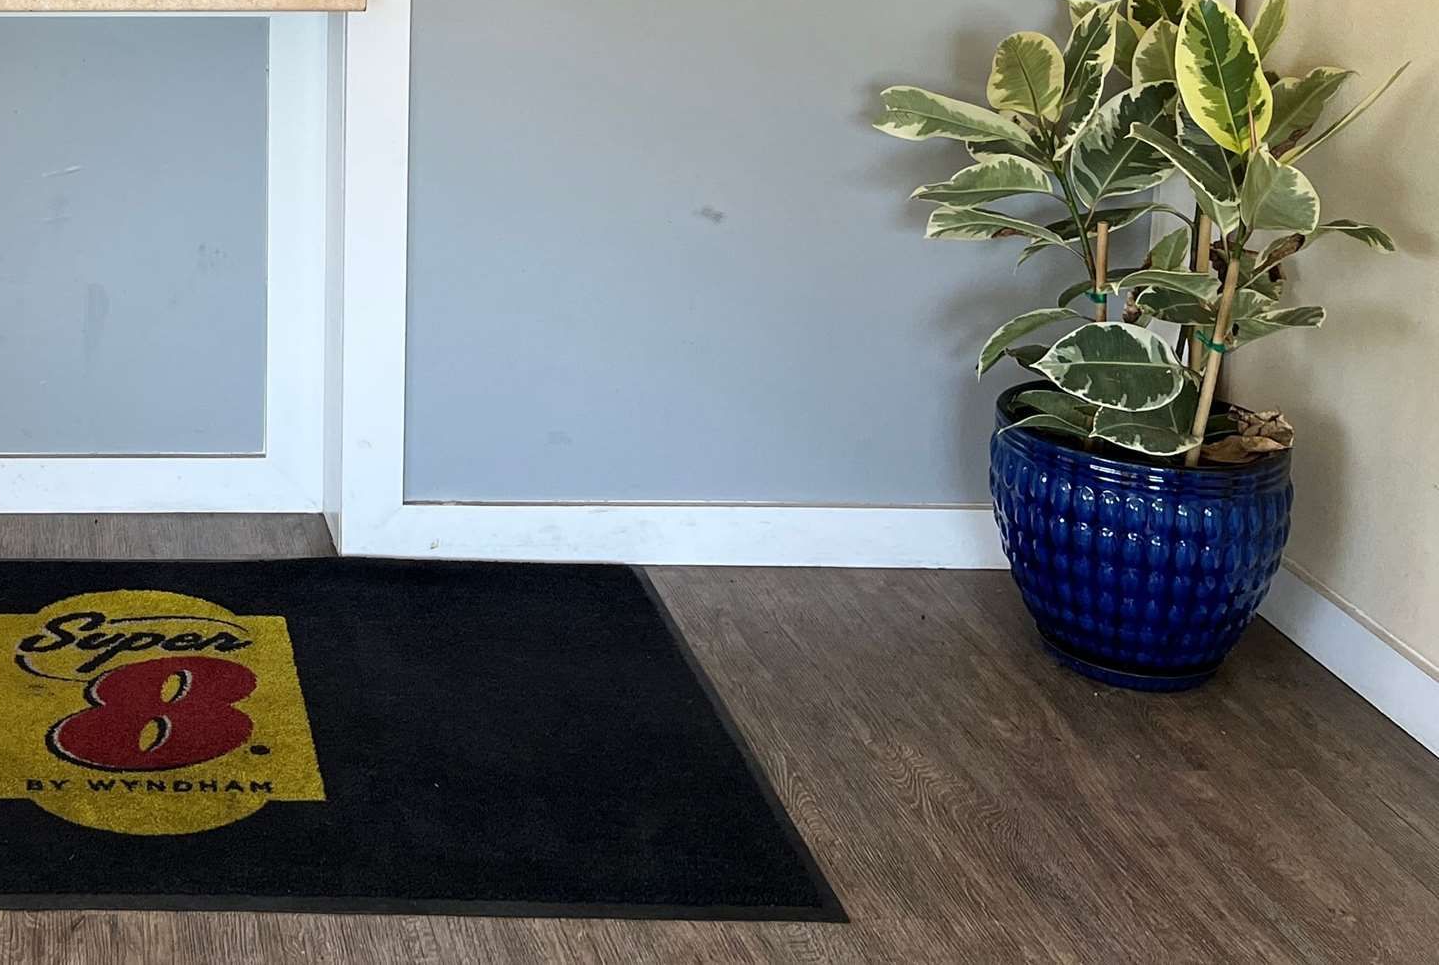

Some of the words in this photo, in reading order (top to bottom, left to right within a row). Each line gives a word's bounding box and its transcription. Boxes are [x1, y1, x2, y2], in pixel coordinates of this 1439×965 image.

[17, 612, 253, 676] Super
[45, 656, 258, 772] 8
[26, 779, 70, 791] BY
[87, 779, 275, 794] WYNDHAM
